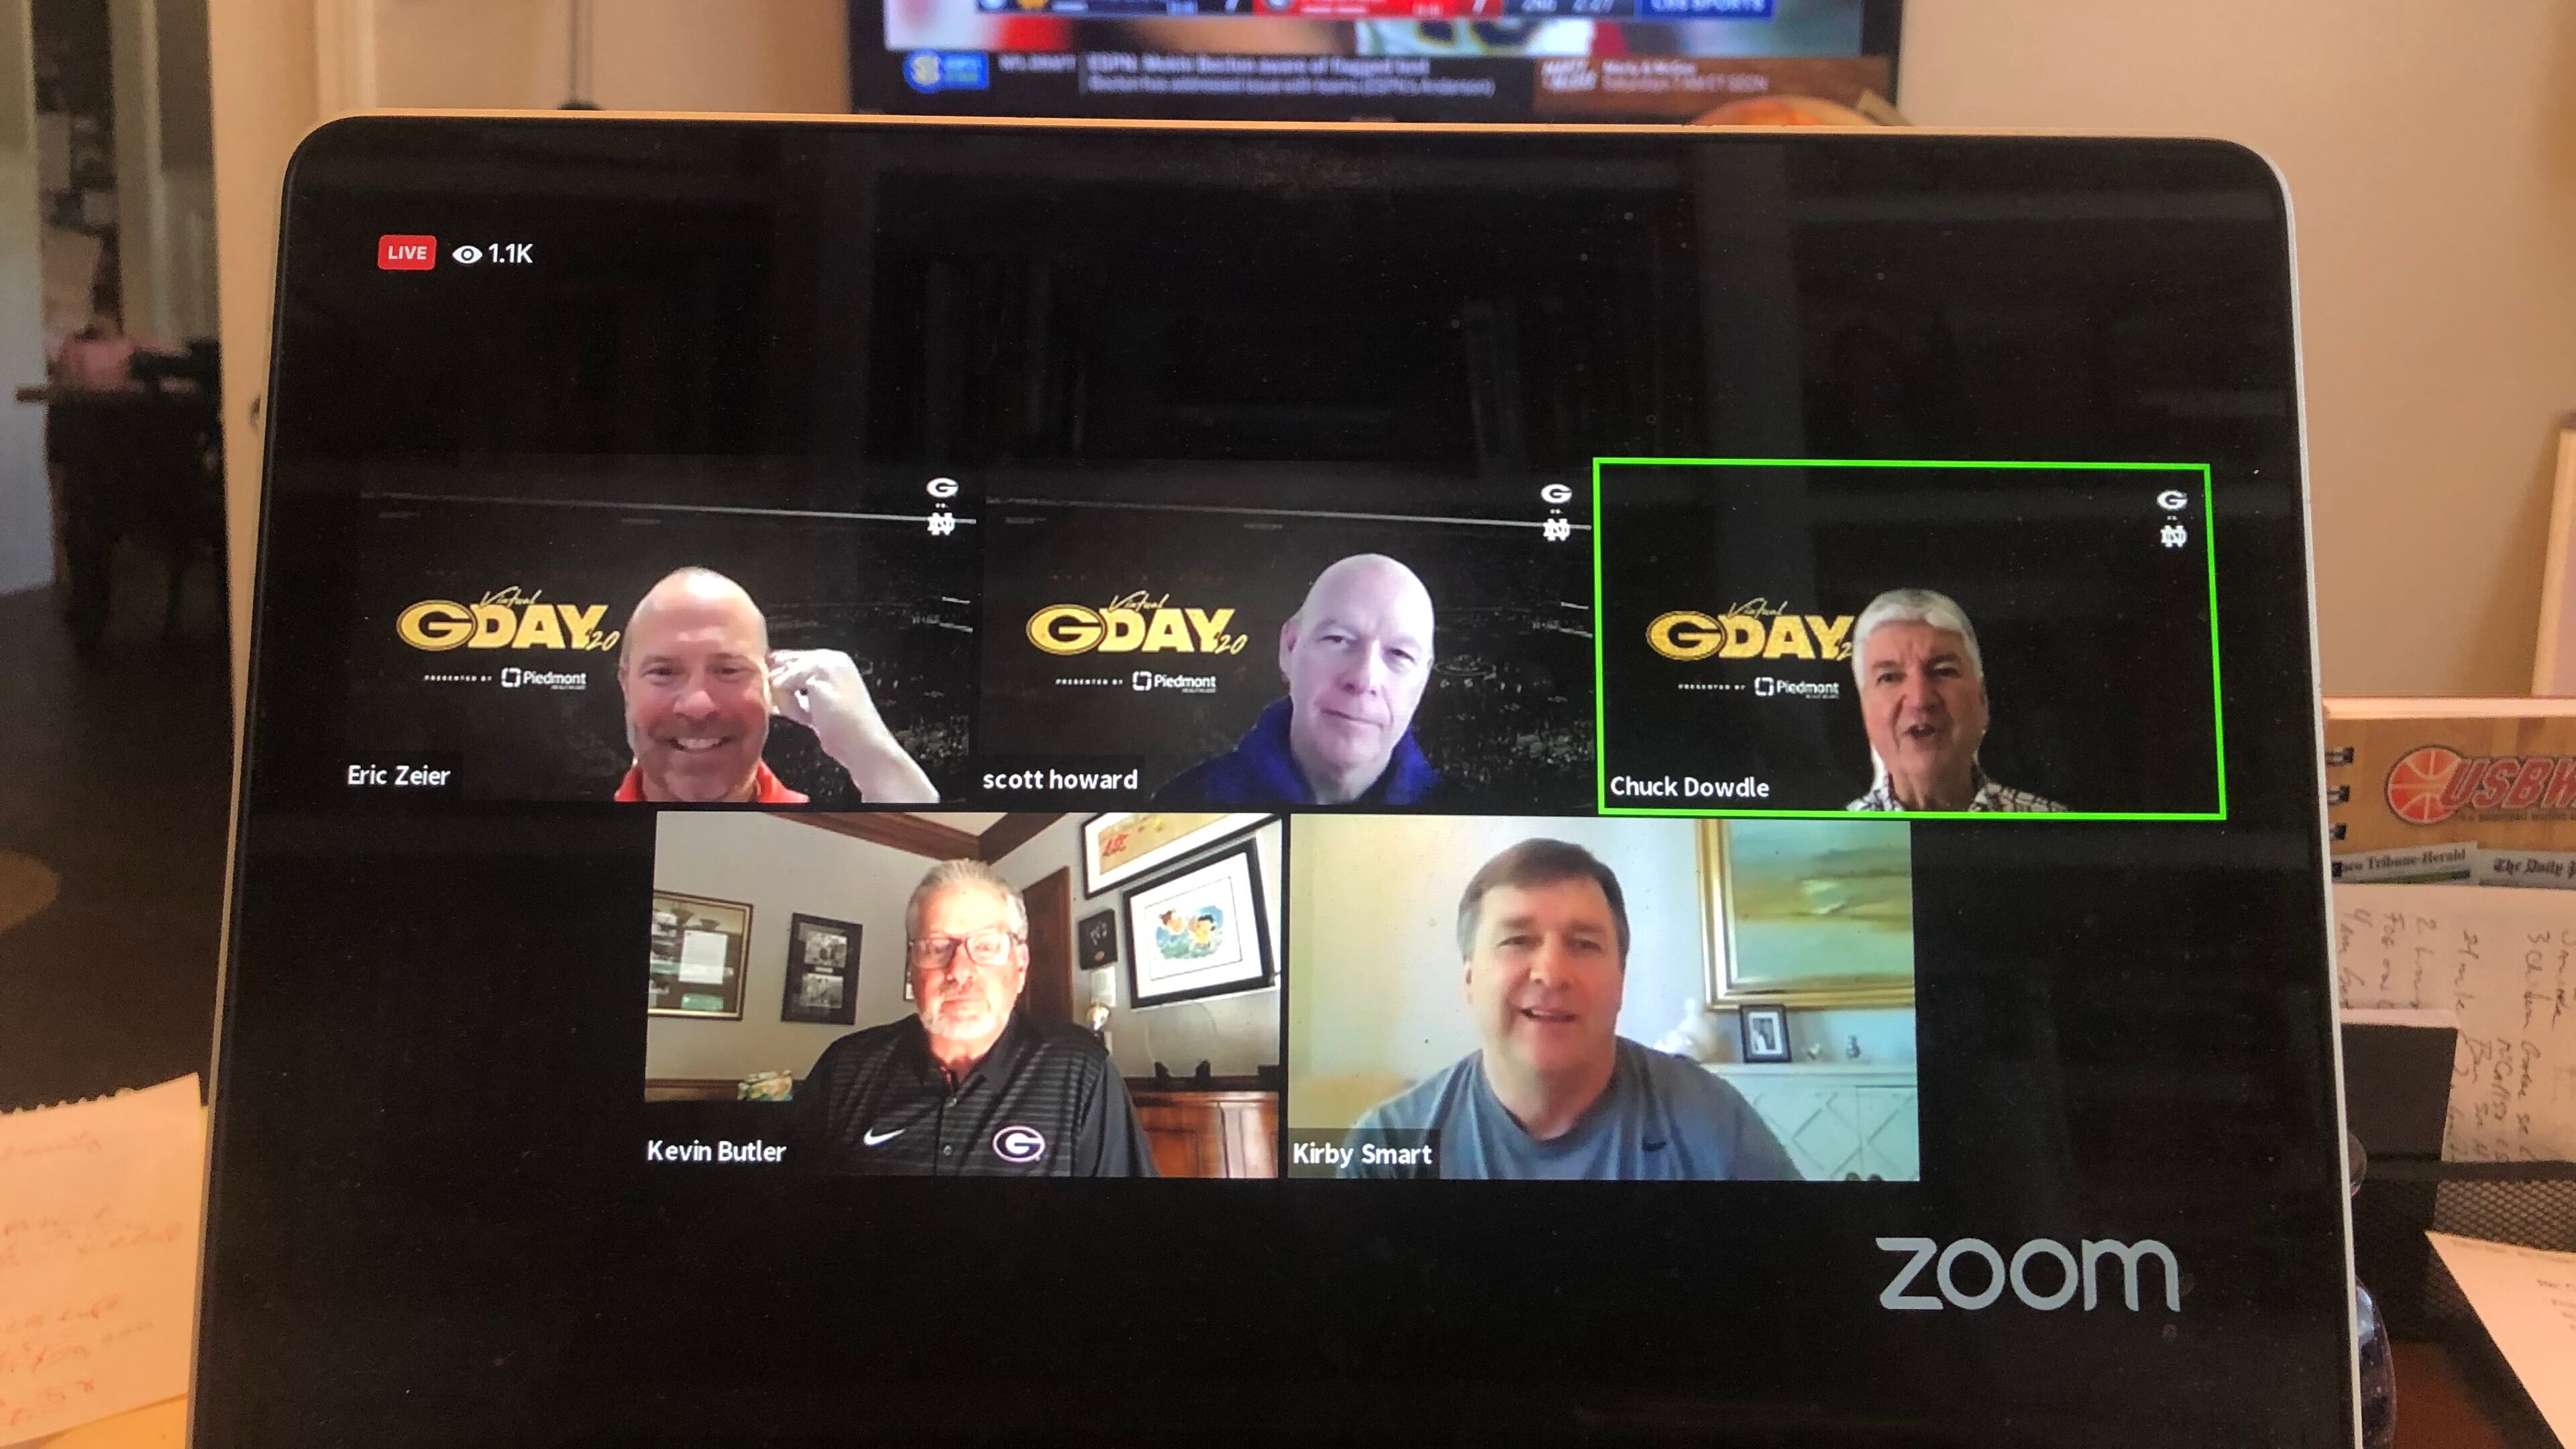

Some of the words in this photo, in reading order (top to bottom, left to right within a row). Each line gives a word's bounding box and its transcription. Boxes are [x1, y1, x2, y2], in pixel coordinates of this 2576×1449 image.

[388, 245, 428, 260] LIVE
[488, 244, 534, 264] 1.1K
[523, 670, 587, 685] Piedmont
[1153, 674, 1217, 688] Piedmont
[1776, 679, 1839, 694] Piedmont
[347, 763, 388, 785] Eric
[394, 764, 451, 786] Zeier
[982, 769, 1044, 790] scott
[1049, 768, 1138, 790] howard
[1610, 775, 1678, 797] Chuck
[1684, 775, 1770, 798] Dowdle
[647, 1138, 712, 1161] Kevin
[717, 1139, 788, 1162] Butler
[1293, 1142, 1354, 1169] Kirby
[1361, 1143, 1433, 1165] Smart
